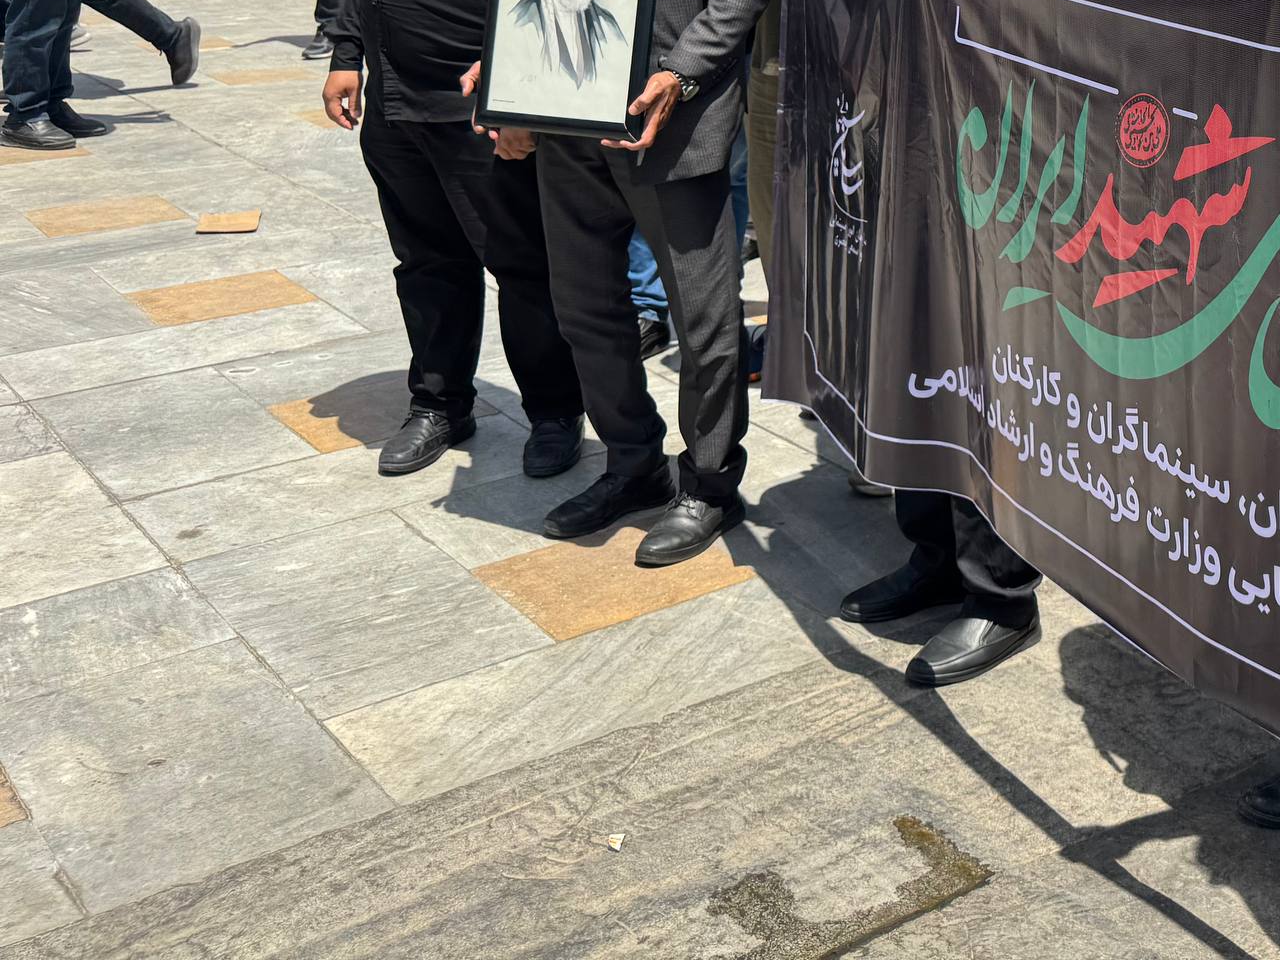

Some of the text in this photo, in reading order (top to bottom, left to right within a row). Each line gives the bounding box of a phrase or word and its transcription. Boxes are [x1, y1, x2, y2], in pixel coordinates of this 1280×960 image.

[956, 78, 1090, 311] ایران
[1054, 103, 1277, 309] شهید
[907, 364, 986, 419] اسلامی
[991, 343, 1062, 408] کارکنان
[1066, 392, 1082, 429] و
[986, 398, 1035, 462] ارشاد
[1039, 441, 1053, 478] و
[1087, 400, 1232, 504] سینماگران
[1057, 441, 1141, 523] فرهنگ
[1146, 505, 1222, 586] وزارت
